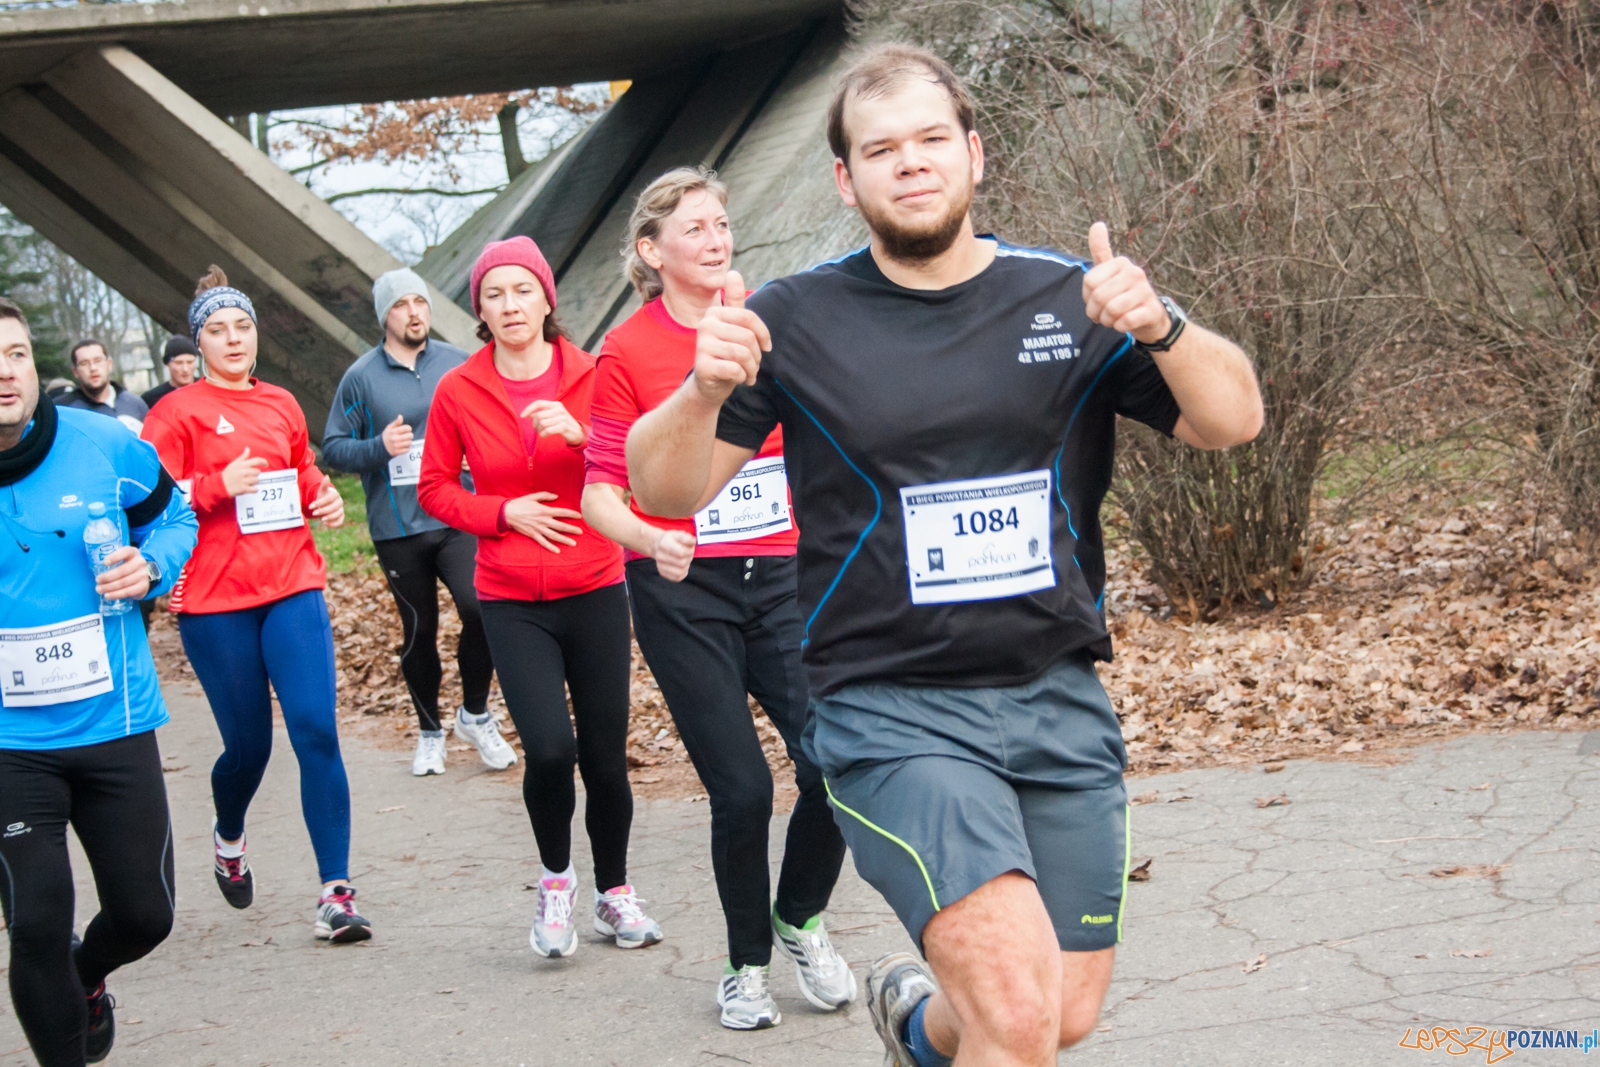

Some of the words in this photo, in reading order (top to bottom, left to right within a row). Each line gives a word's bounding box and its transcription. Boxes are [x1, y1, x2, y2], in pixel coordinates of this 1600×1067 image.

[1022, 333, 1072, 350] MARATON
[1018, 352, 1032, 364] 42
[1033, 351, 1051, 362] km
[409, 451, 422, 462] 64
[262, 487, 283, 501] 237
[730, 482, 762, 502] 961
[935, 490, 984, 504] POWSTANIA
[953, 506, 1019, 536] 1084
[968, 544, 1017, 570] parkrun
[35, 641, 73, 663] 848
